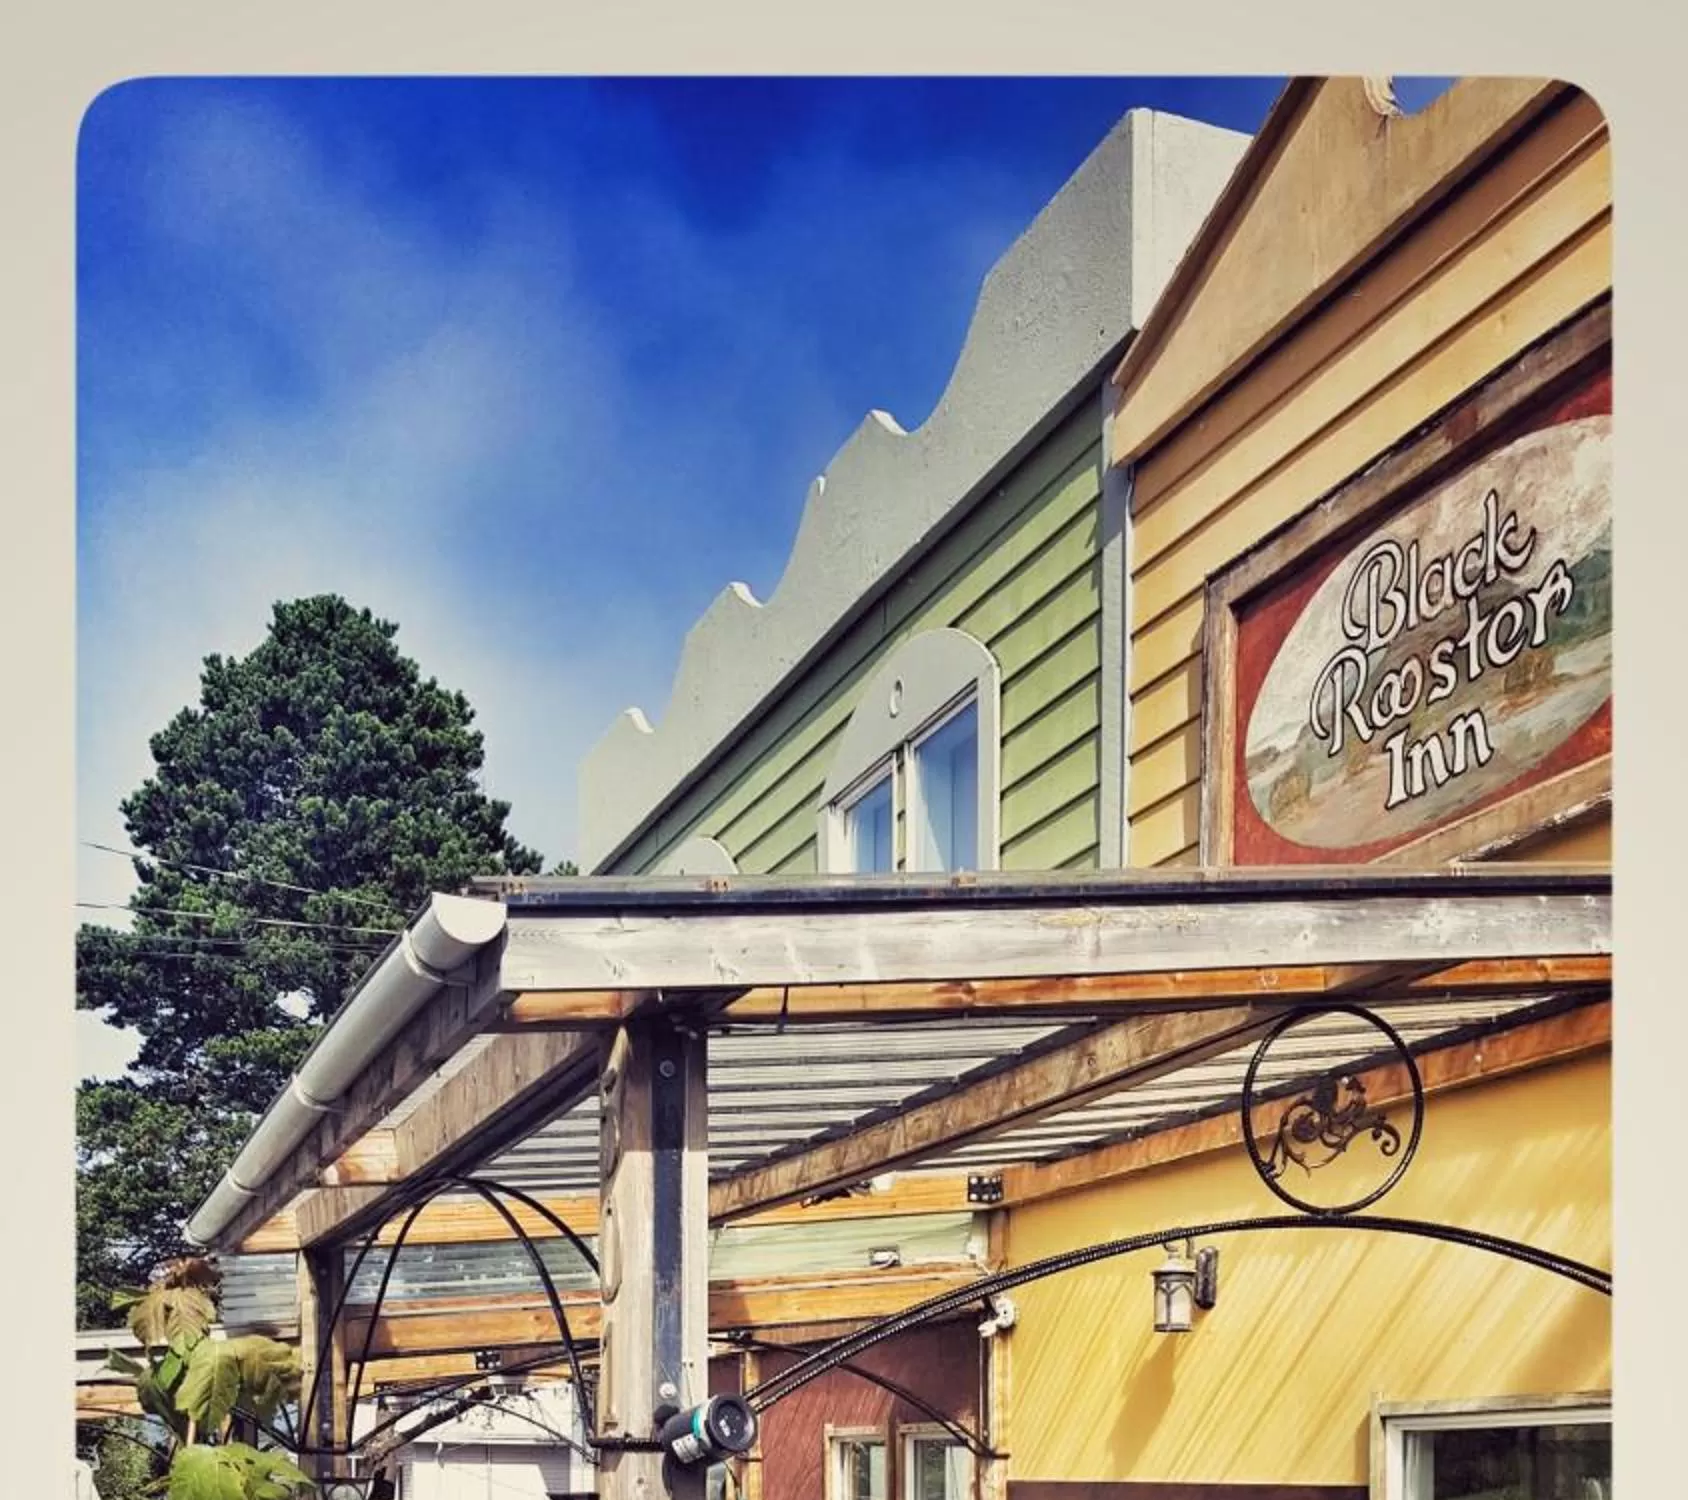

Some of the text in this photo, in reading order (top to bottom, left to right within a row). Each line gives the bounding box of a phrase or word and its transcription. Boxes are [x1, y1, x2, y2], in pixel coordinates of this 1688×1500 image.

[1342, 488, 1537, 655] Black
[1309, 558, 1576, 758] Rooster
[1383, 708, 1495, 810] Inn
